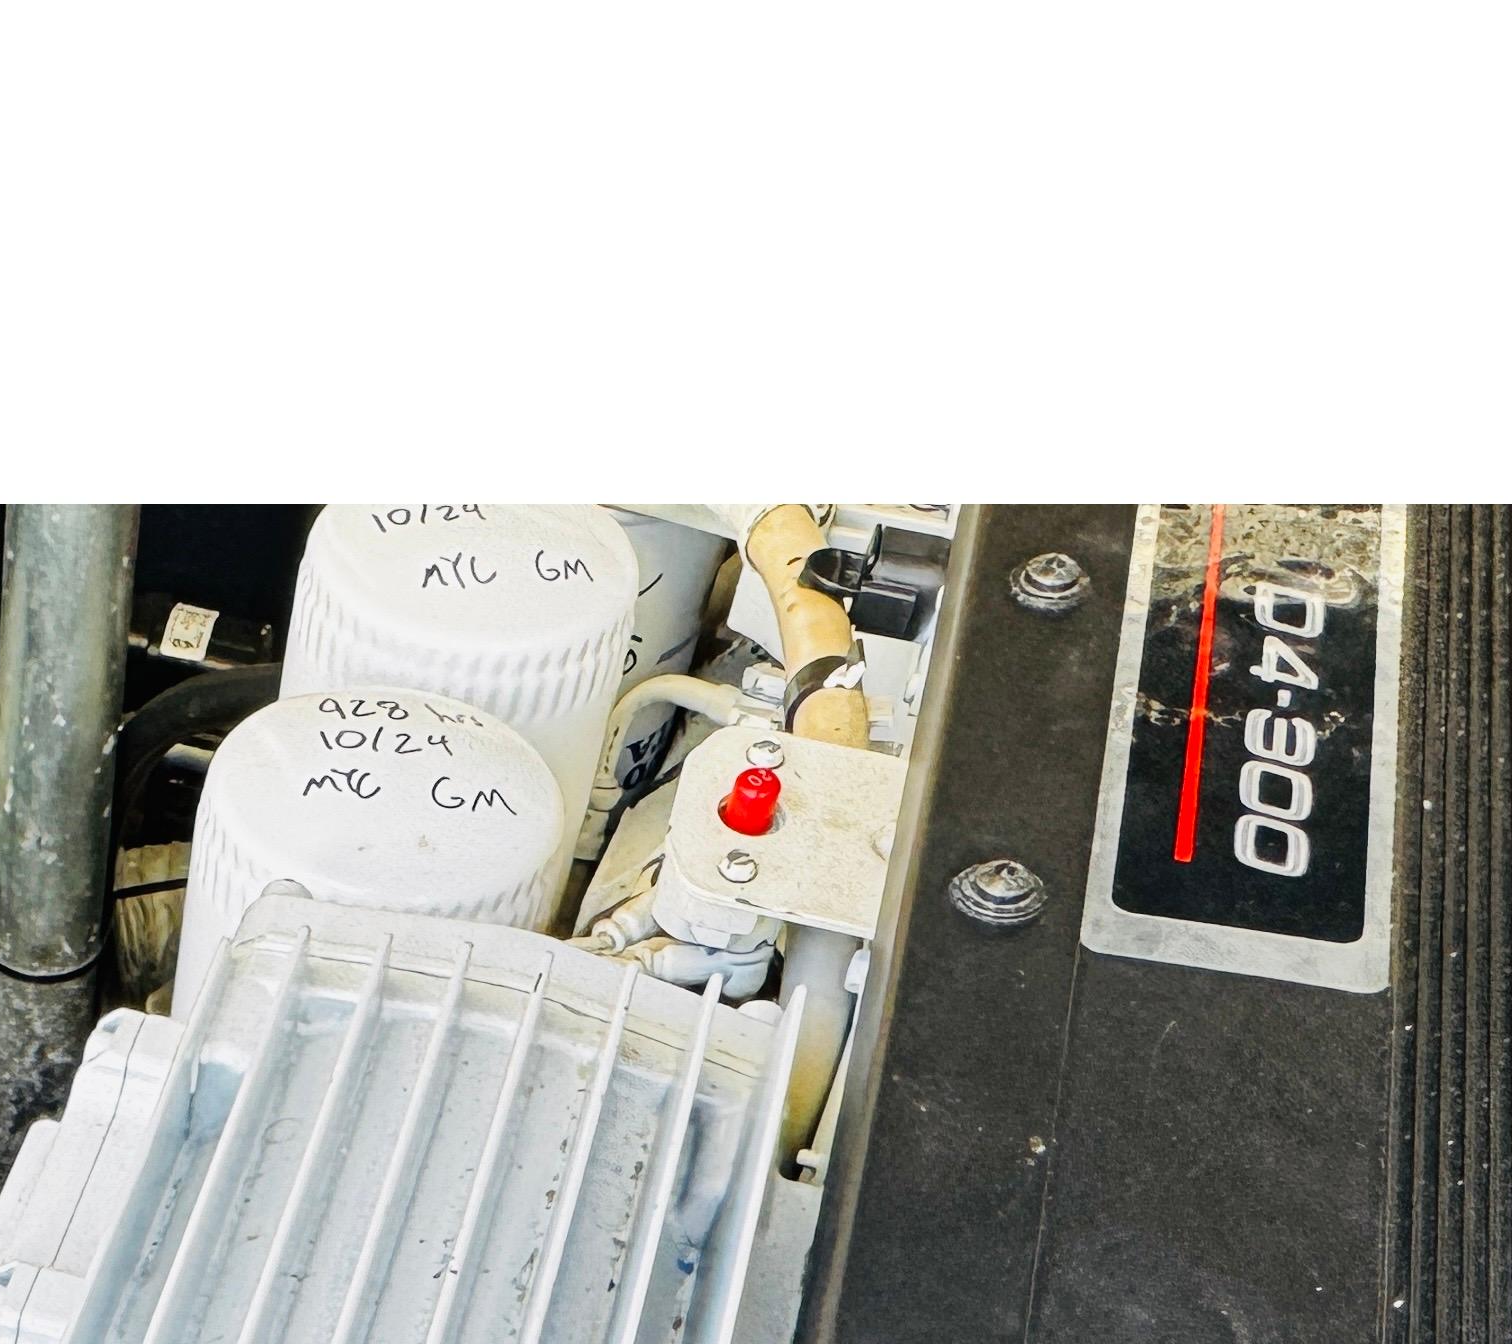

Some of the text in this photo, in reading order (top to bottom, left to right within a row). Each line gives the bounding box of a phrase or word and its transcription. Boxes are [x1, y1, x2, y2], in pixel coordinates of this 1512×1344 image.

[372, 504, 487, 533] 10/24
[319, 698, 410, 720] 928
[319, 726, 453, 757] 10/24
[1233, 581, 1326, 878] D4-300
[431, 776, 518, 816] GM
